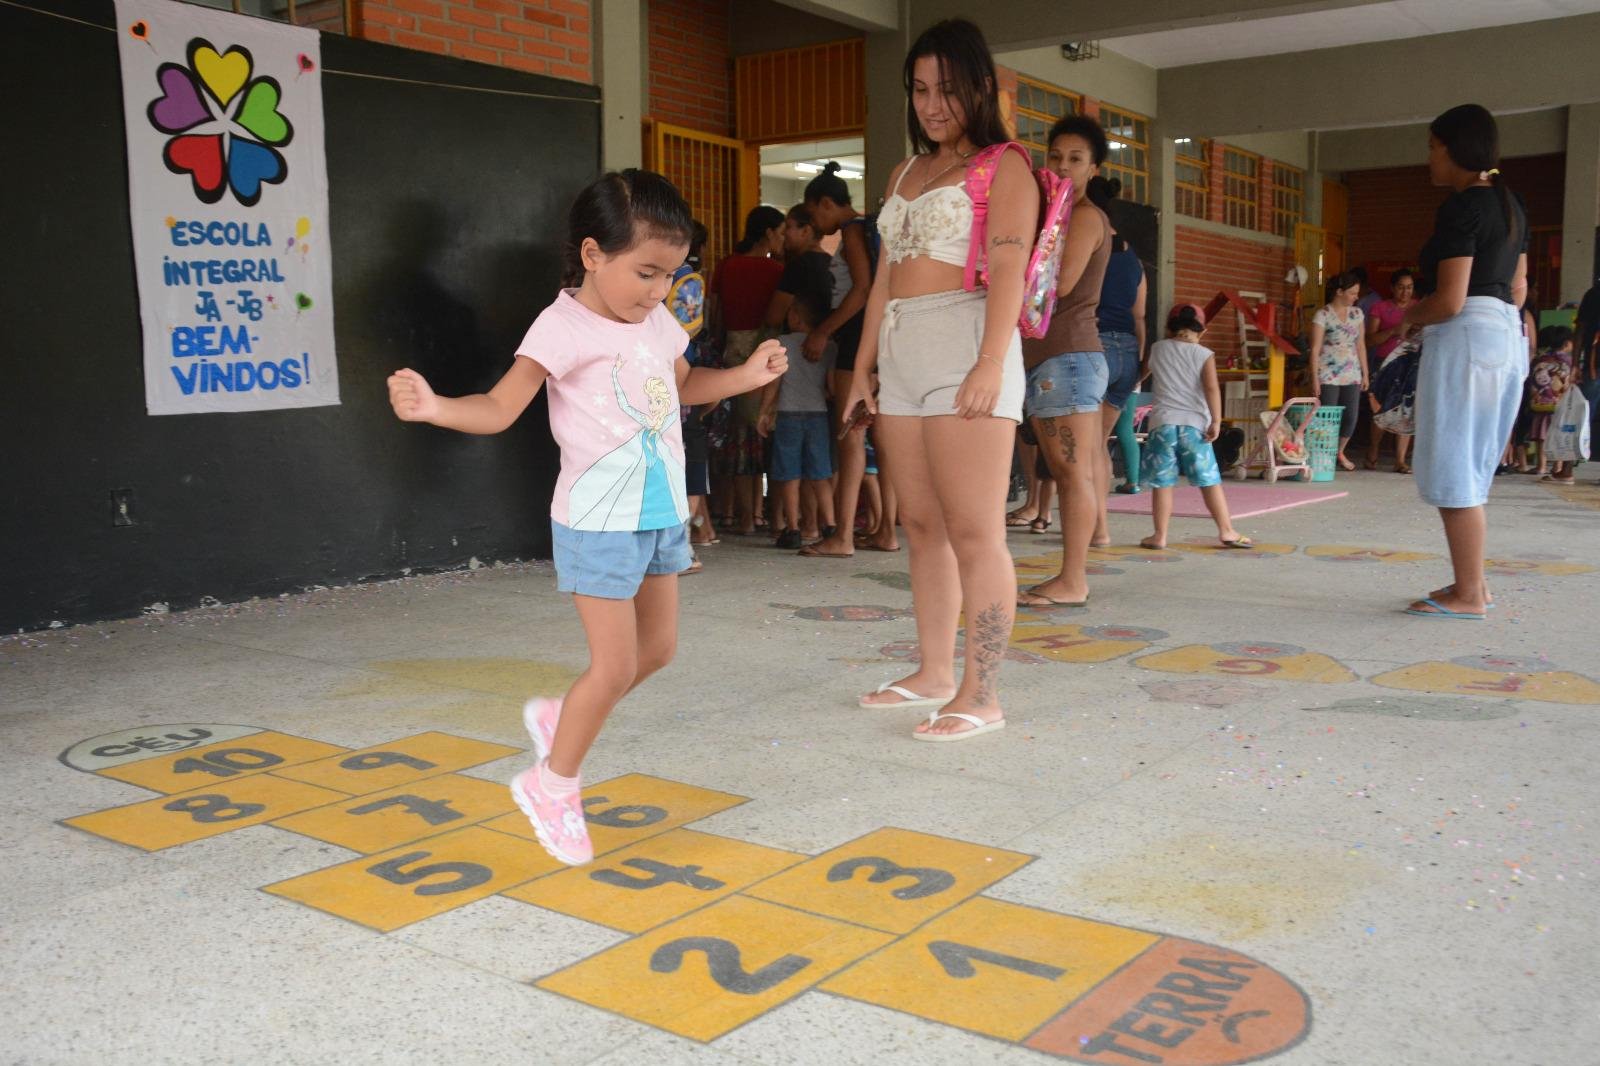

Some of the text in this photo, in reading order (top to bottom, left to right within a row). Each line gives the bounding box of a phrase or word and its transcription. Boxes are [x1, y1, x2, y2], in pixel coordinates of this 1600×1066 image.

[171, 220, 272, 246] ESCOLA
[171, 325, 260, 357] BEM-
[172, 748, 285, 777] 10
[339, 751, 439, 770] 9
[162, 794, 266, 823] 8
[345, 794, 465, 825] 7
[581, 796, 669, 828] 6
[366, 851, 493, 896] 5
[589, 858, 727, 890] 4
[826, 856, 956, 900] 3
[649, 936, 813, 995] 2
[927, 940, 1068, 981] 1
[1080, 957, 1259, 1064] TERRA
